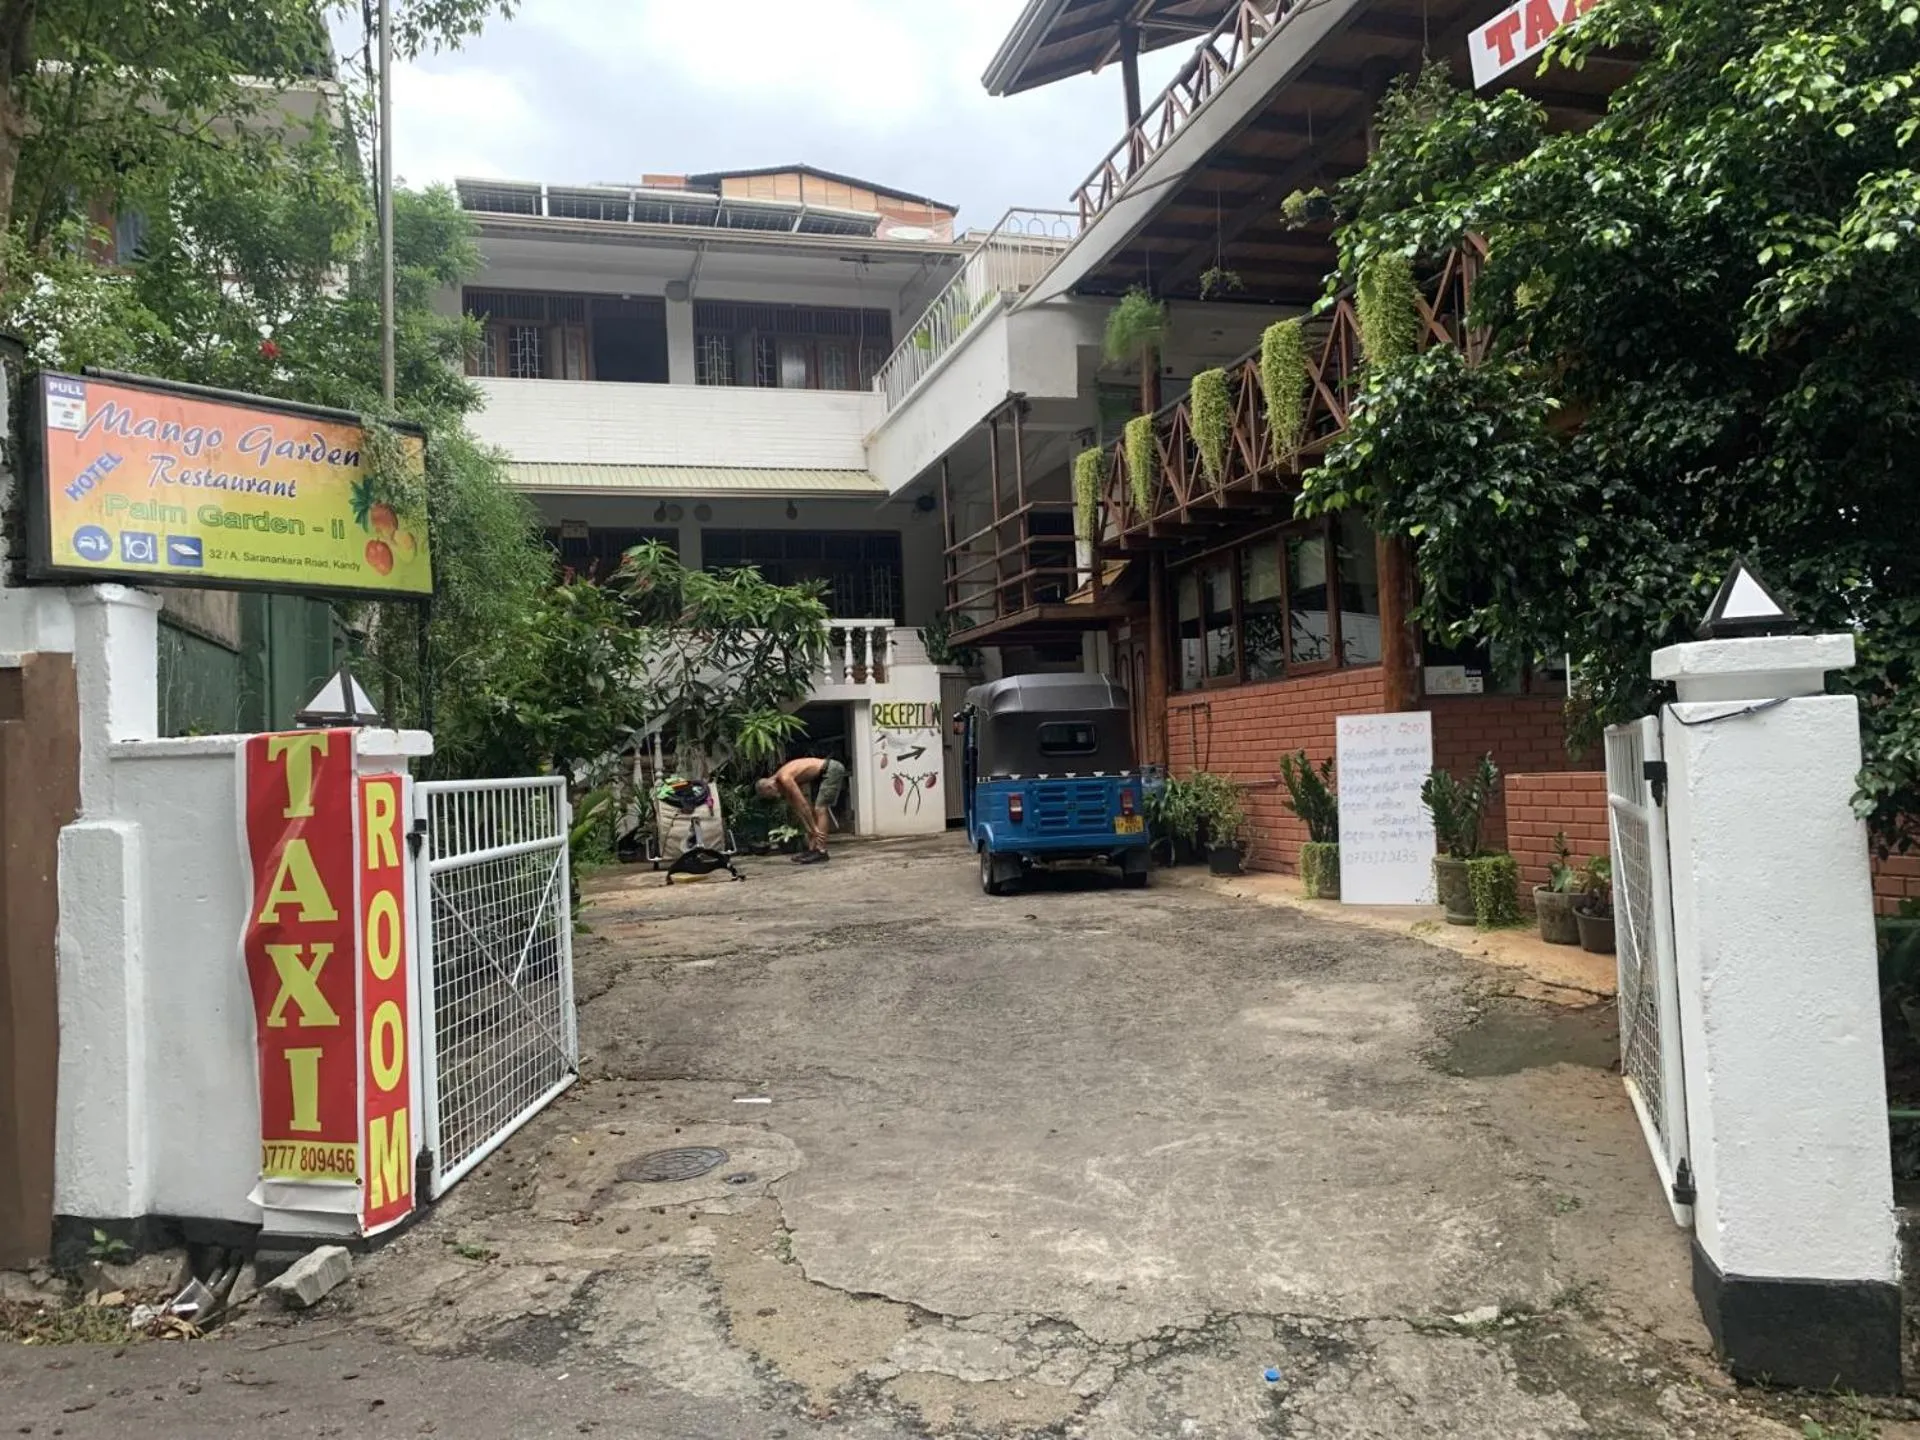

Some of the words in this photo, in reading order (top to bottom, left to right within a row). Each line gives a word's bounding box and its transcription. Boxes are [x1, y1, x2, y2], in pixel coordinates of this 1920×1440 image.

[48, 381, 84, 396] PULL
[76, 402, 223, 456] Mango
[237, 425, 361, 468] Garden
[64, 451, 124, 501] HOTEL
[149, 455, 297, 498] Restaurant
[102, 493, 188, 525] Palm
[197, 504, 306, 536] Garden
[333, 559, 361, 573] Kandy
[258, 734, 339, 1132] TAXI
[365, 781, 411, 1210] ROOM
[299, 1145, 356, 1174] 809456
